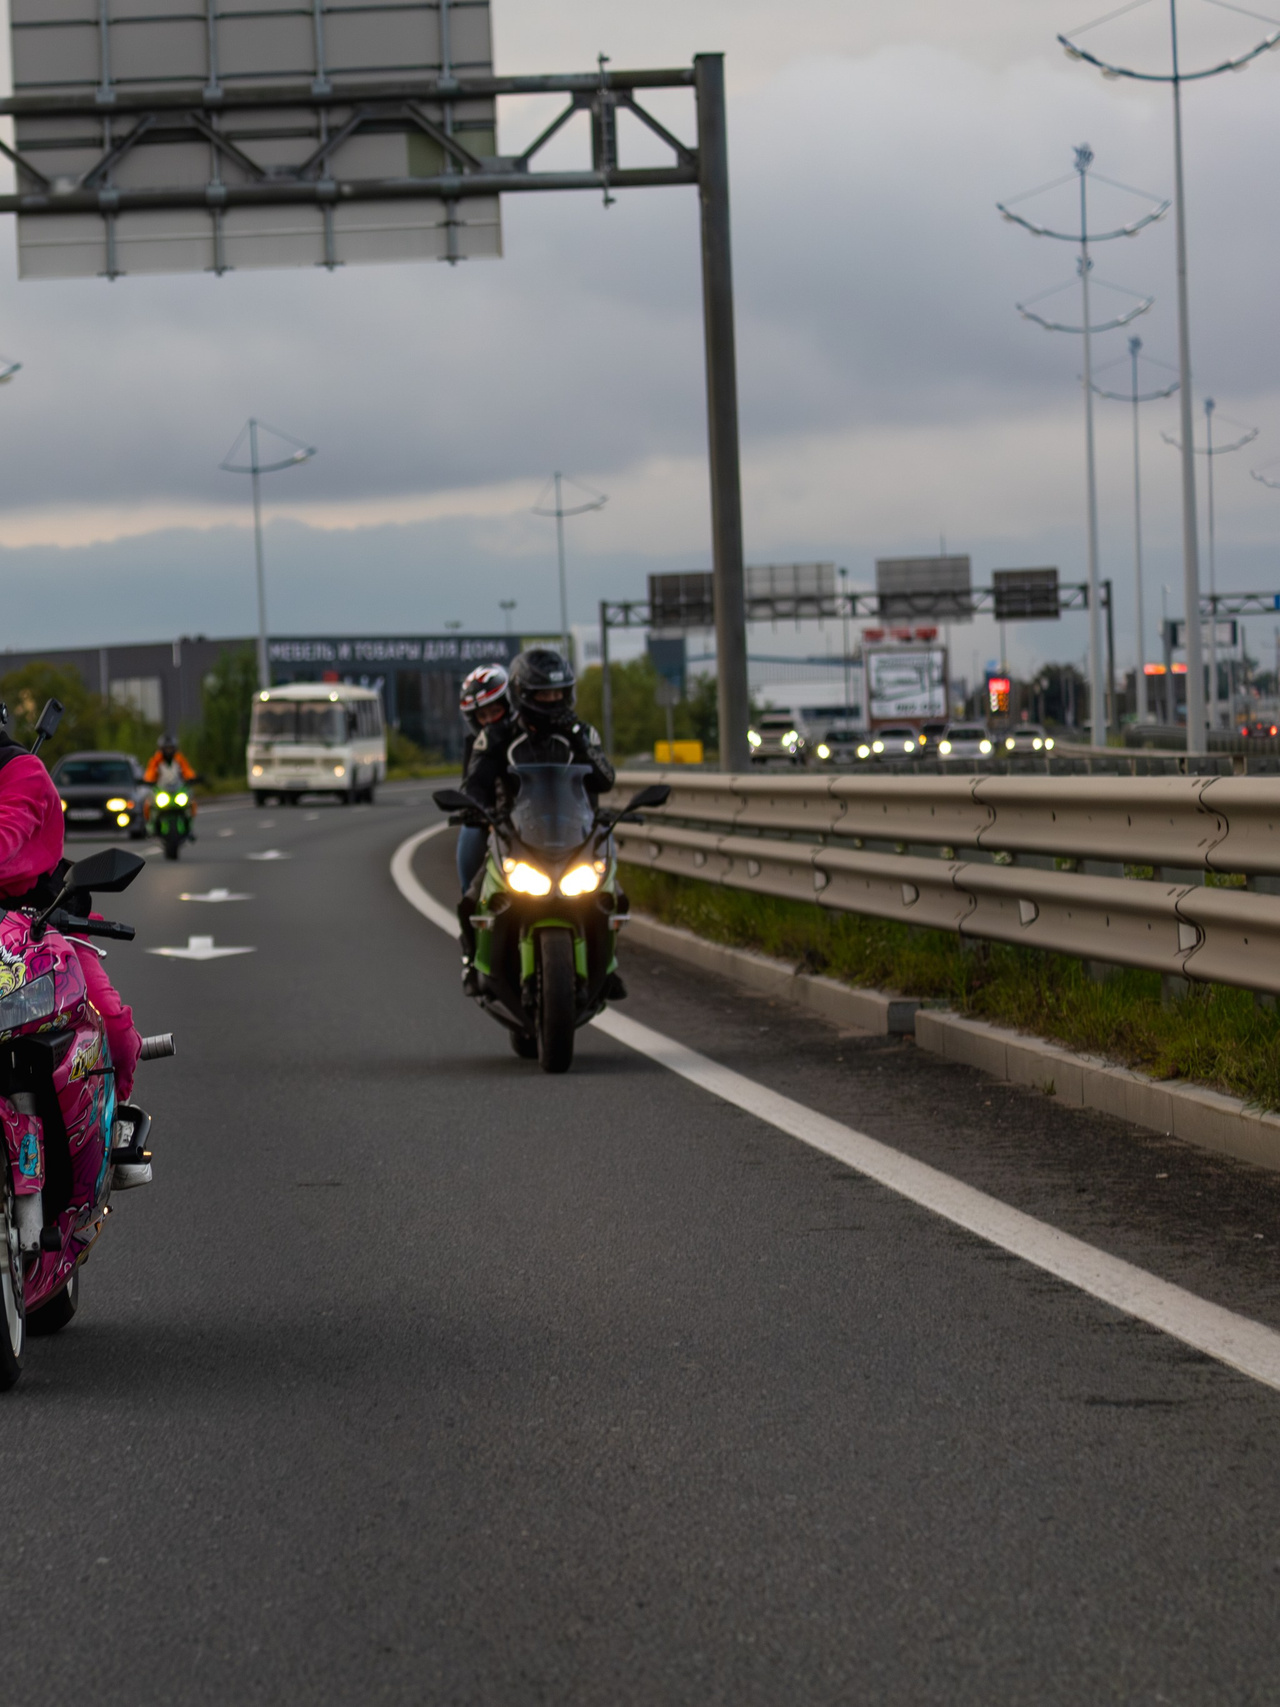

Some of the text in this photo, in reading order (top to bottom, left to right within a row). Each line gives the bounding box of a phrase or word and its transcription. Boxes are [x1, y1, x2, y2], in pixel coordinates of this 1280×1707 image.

[269, 641, 336, 661] МЕБЕЛЬ
[337, 641, 352, 661] И
[354, 640, 422, 661] ТОВАРЫ
[423, 639, 458, 662] ДЛЯ
[460, 639, 509, 661] ДОМА
